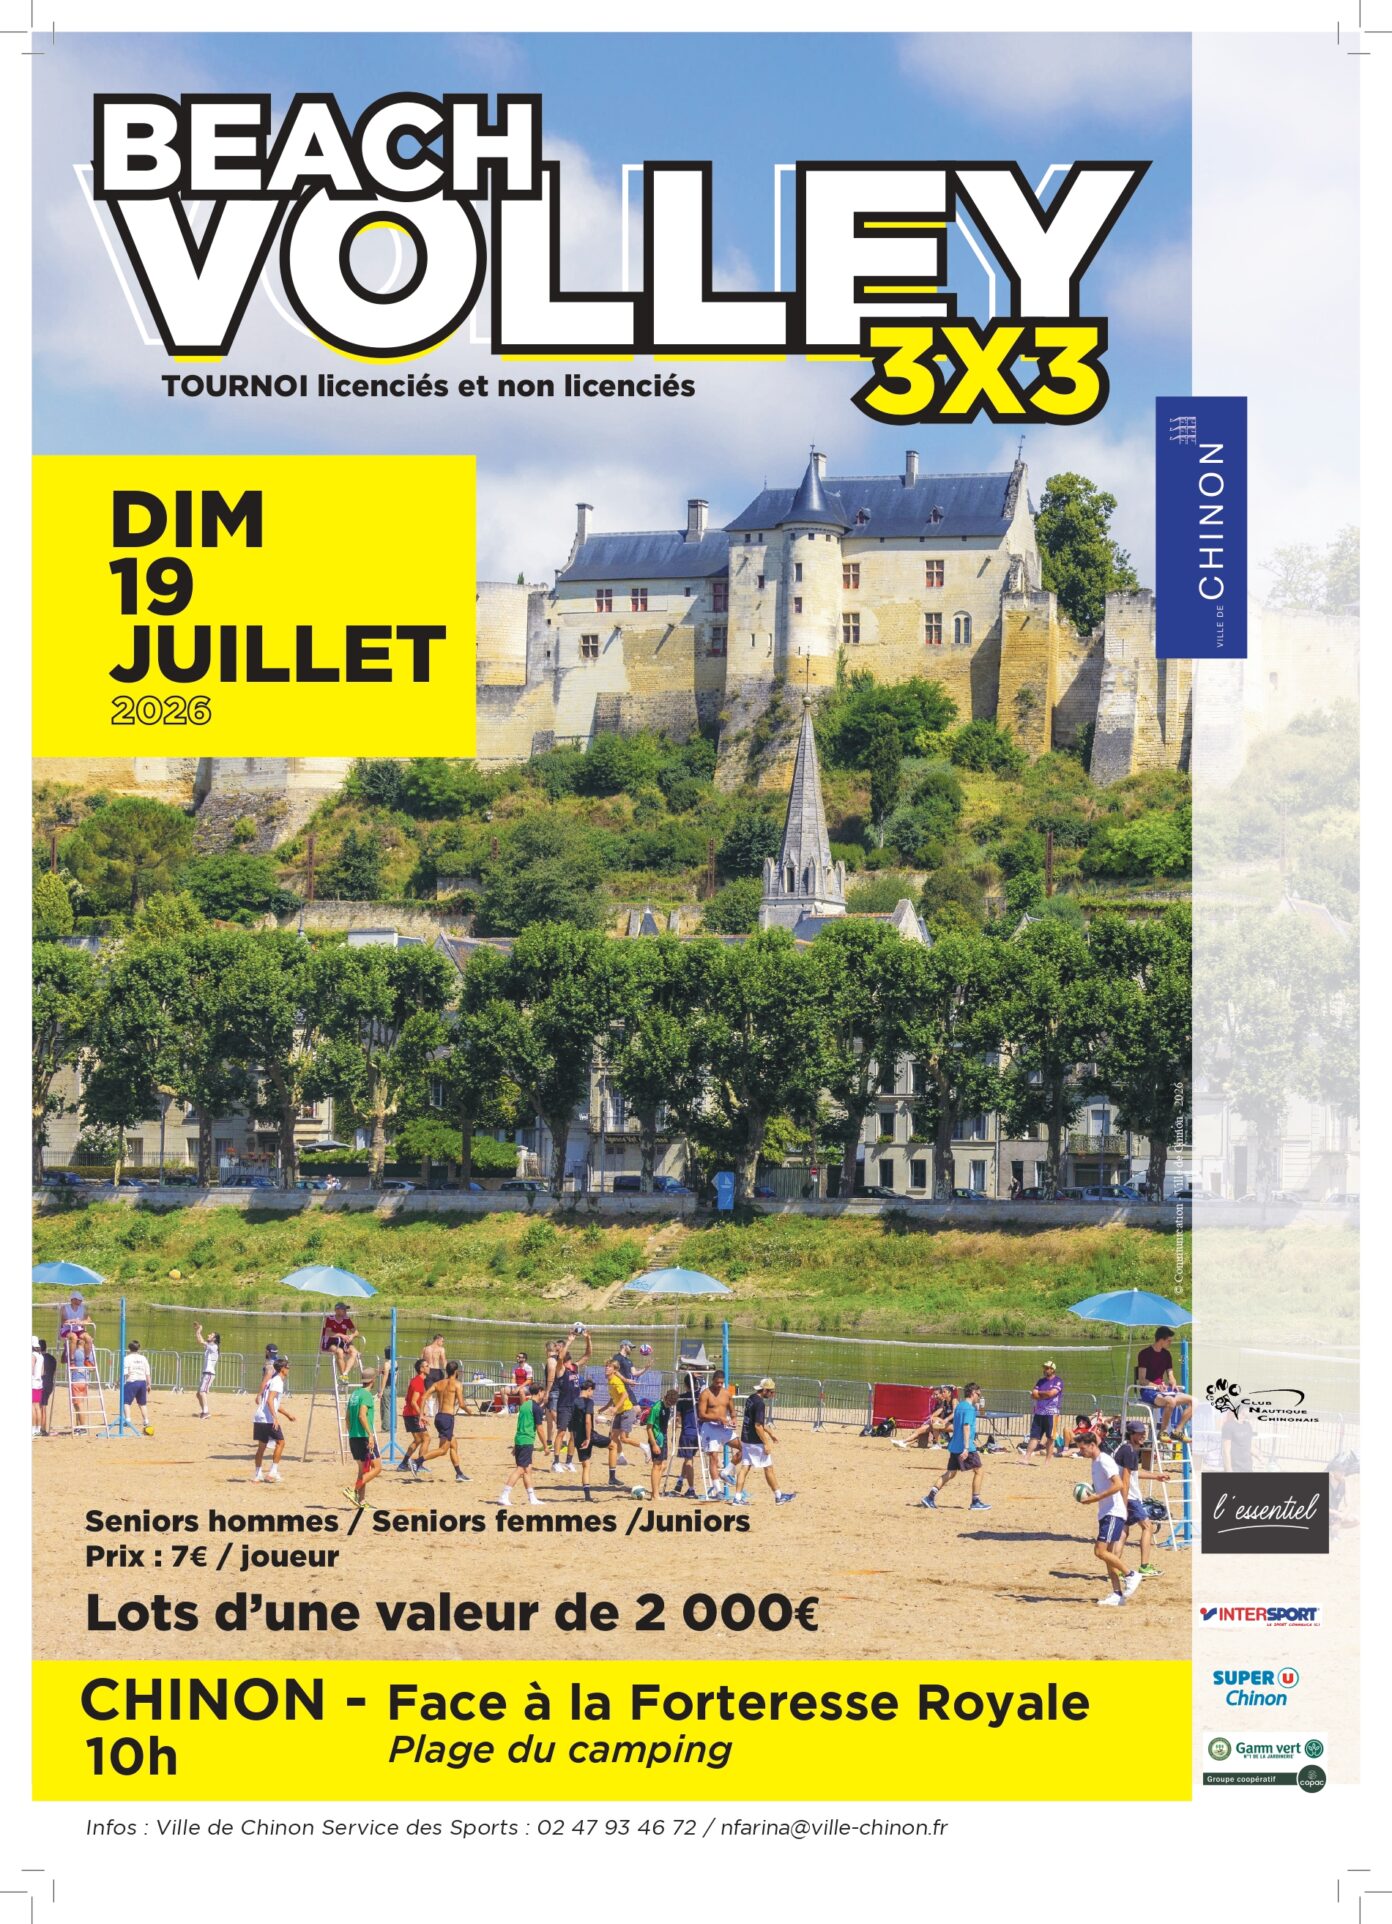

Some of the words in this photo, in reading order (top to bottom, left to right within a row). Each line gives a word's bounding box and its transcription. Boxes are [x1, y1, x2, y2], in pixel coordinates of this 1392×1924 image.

[94, 92, 542, 201] BEACH
[92, 160, 1153, 359] VOLLEY
[161, 374, 307, 397] TOURNOI
[318, 373, 449, 397] licenciés
[458, 375, 489, 397] et
[498, 379, 554, 397] non
[565, 373, 696, 397] licenciés
[851, 317, 1110, 425] 3X3
[113, 490, 263, 548] DIM
[1199, 443, 1225, 600] CHINON
[109, 556, 193, 616] 19
[1216, 605, 1224, 618] DE
[1216, 622, 1224, 648] VILLE
[109, 625, 447, 684] JUILLET
[111, 695, 212, 726] 2026
[1174, 1082, 1184, 1107] 2026
[1173, 1116, 1184, 1153] Chinon
[1174, 1155, 1184, 1168] de
[1174, 1203, 1184, 1283] Communication
[86, 1509, 199, 1532] Seniors
[209, 1509, 339, 1532] hommes
[347, 1507, 365, 1536] /
[372, 1509, 486, 1532] Seniors
[495, 1509, 617, 1532] femmes
[625, 1507, 750, 1536] /Juniors
[1213, 1492, 1321, 1521] l'essentiel
[86, 1544, 145, 1567] Prix
[171, 1545, 207, 1567] 7€
[216, 1542, 233, 1571] /
[239, 1544, 340, 1572] joueur
[88, 1593, 199, 1632] Lots
[215, 1592, 360, 1632] d’une
[376, 1592, 539, 1632] valeur
[555, 1592, 619, 1632] de
[635, 1593, 665, 1631] 2
[683, 1593, 819, 1632] 000€
[1219, 1607, 1318, 1621] INTERSPORT
[1213, 1670, 1275, 1686] SUPER
[81, 1677, 323, 1721] CHINON
[389, 1684, 507, 1721] Face
[524, 1680, 550, 1721] à
[571, 1682, 610, 1721] la
[632, 1684, 899, 1721] Forteresse
[919, 1682, 1090, 1729] Royale
[1226, 1690, 1288, 1707] Chinon
[86, 1735, 177, 1776] 10h
[388, 1734, 494, 1770] Plage
[508, 1734, 556, 1764] du
[568, 1734, 733, 1770] camping
[1236, 1742, 1273, 1754] Gamm
[1276, 1742, 1301, 1754] vert
[1206, 1775, 1235, 1784] Groupe
[1236, 1775, 1276, 1784] coopératif
[1299, 1779, 1324, 1788] copac
[86, 1818, 137, 1836] Infos
[156, 1818, 201, 1836] Ville
[207, 1818, 234, 1836] de
[241, 1818, 314, 1836] Chinon
[321, 1818, 399, 1836] Service
[406, 1818, 442, 1836] des
[449, 1818, 518, 1840] Sports
[537, 1819, 565, 1836] 02
[571, 1819, 599, 1836] 47
[605, 1819, 631, 1836] 93
[637, 1819, 665, 1836] 46
[673, 1819, 697, 1836] 72
[702, 1817, 717, 1839] /
[721, 1818, 949, 1840] nfarina@ville-chinon.fr
